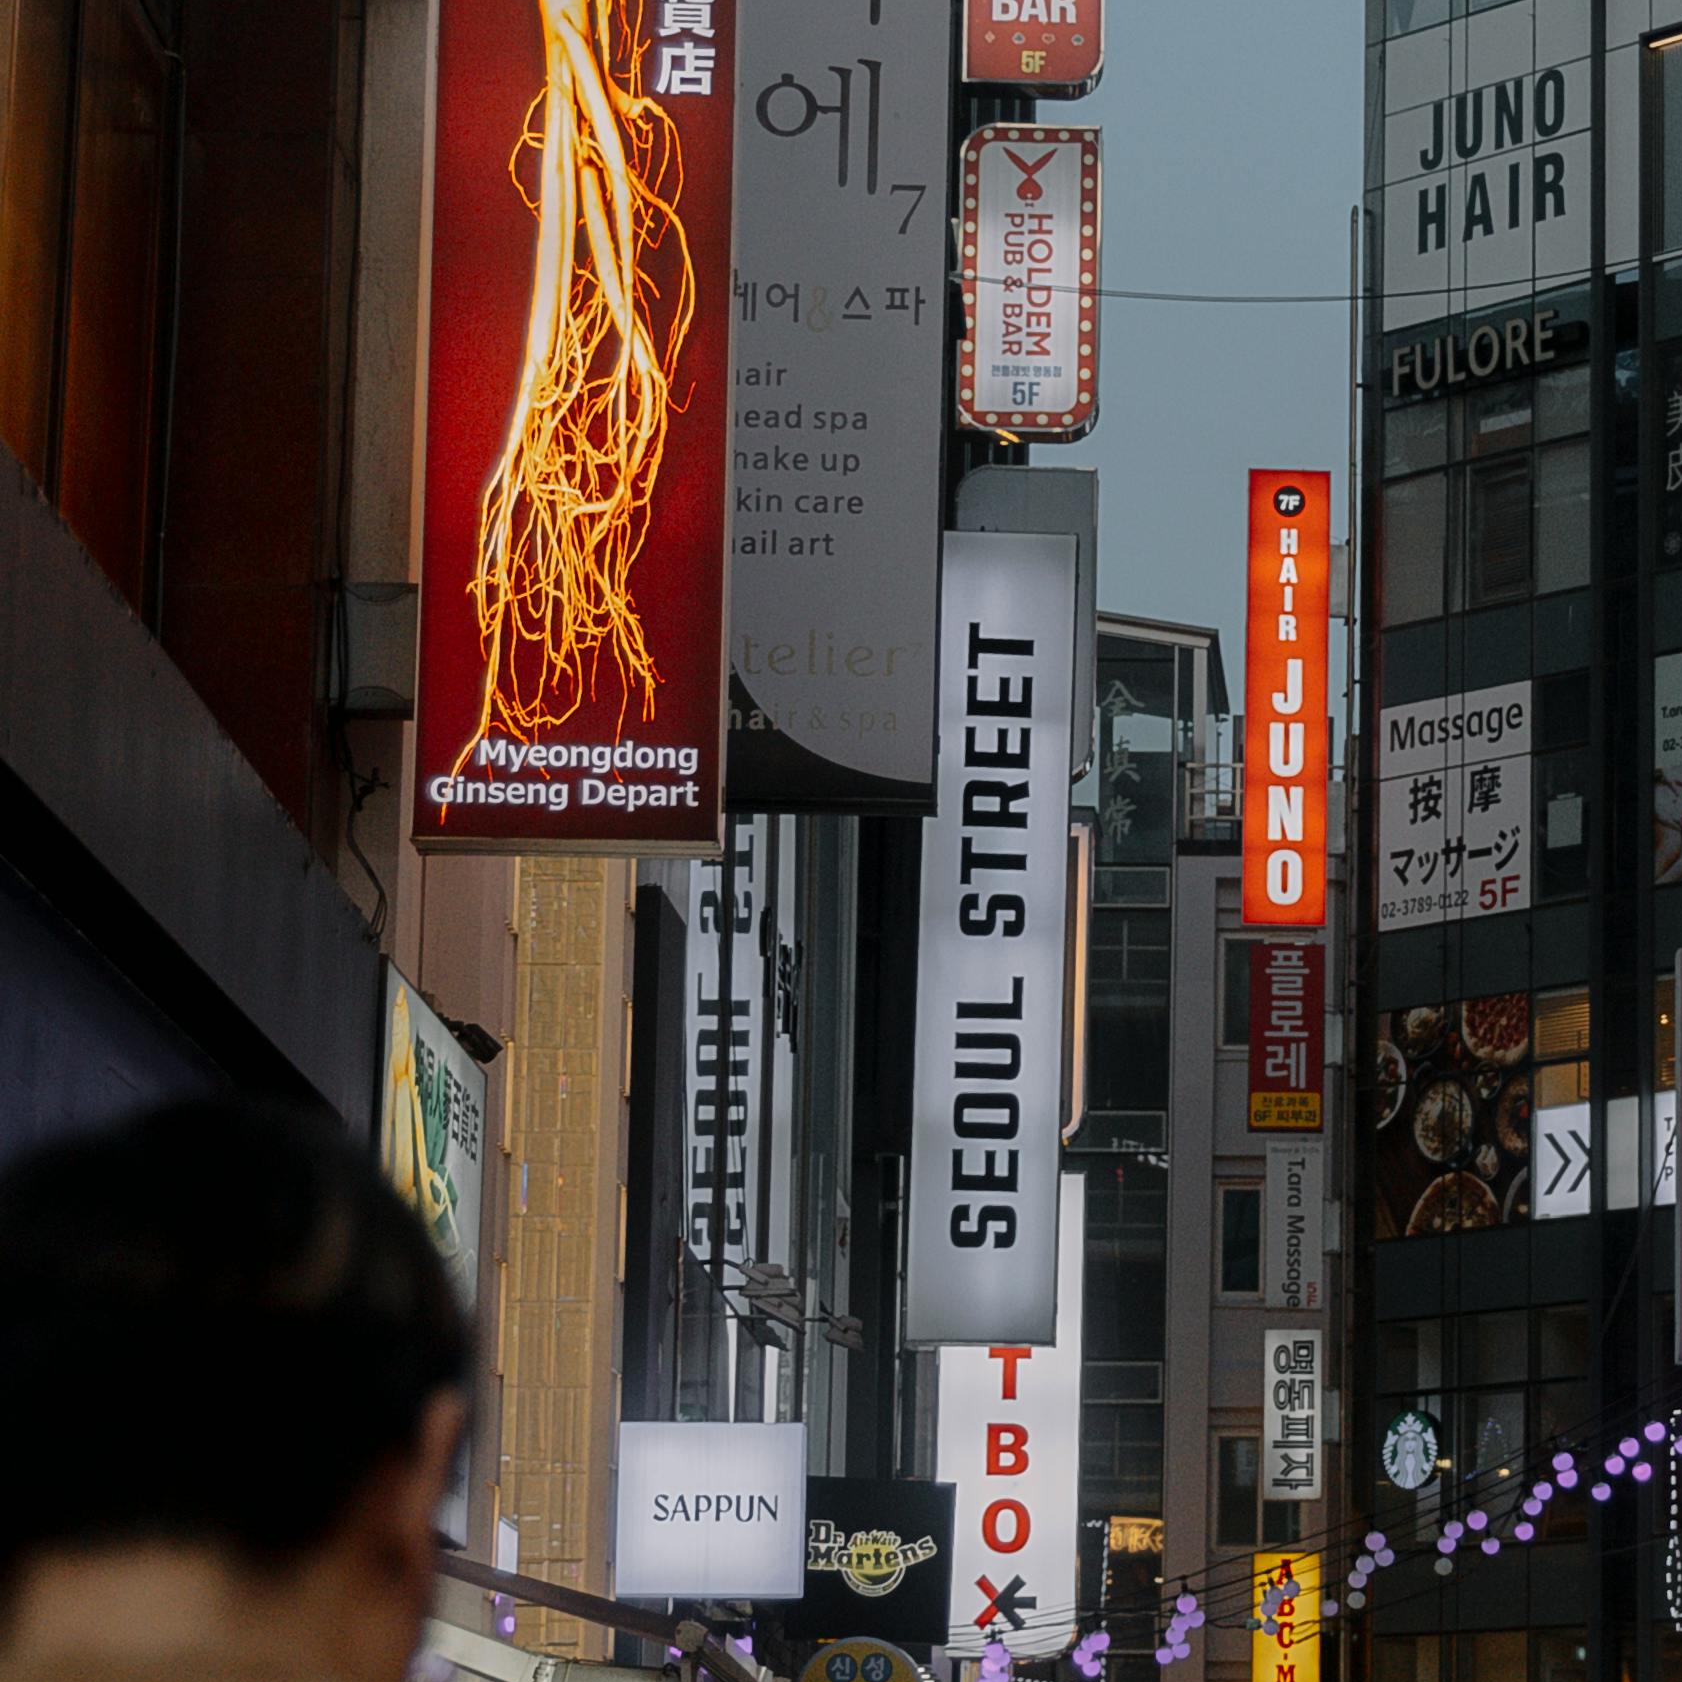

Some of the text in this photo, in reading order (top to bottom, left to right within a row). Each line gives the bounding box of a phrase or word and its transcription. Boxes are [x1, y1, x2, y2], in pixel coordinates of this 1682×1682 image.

[1020, 50, 1046, 74] 5F
[1420, 69, 1566, 171] JUNO
[888, 183, 927, 235] 7
[1417, 152, 1567, 255] HAIR
[1002, 213, 1025, 356] PUB & BAR
[1025, 213, 1054, 358] HOLDEM
[734, 362, 787, 389] air
[1392, 310, 1559, 396] FULORE
[1012, 381, 1041, 407] 5F
[734, 403, 869, 438] ead spa
[821, 450, 861, 480] up
[737, 486, 864, 516] kin care
[1278, 494, 1301, 510] 7F
[732, 528, 835, 556] ail art
[1278, 528, 1299, 641] HAIR
[1390, 702, 1524, 753] Massage
[478, 740, 698, 776] Myeongdong
[958, 621, 1036, 938] STREET
[1265, 659, 1305, 906] JUNO
[430, 778, 699, 813] Ginseng Depart
[1408, 765, 1502, 825] 按摩
[1390, 826, 1520, 886] マッサージ
[1381, 889, 1470, 919] 02-3789-0122
[1479, 874, 1521, 910] 5F
[1264, 950, 1310, 1089] 플로레
[950, 976, 1024, 1250] SEOUL
[1285, 1157, 1305, 1309] T.ara Massage
[1273, 1339, 1315, 1491] 명동피자
[653, 1494, 779, 1522] SAPPUN
[808, 1536, 938, 1570] Martens
[831, 1658, 887, 1679] 신성
